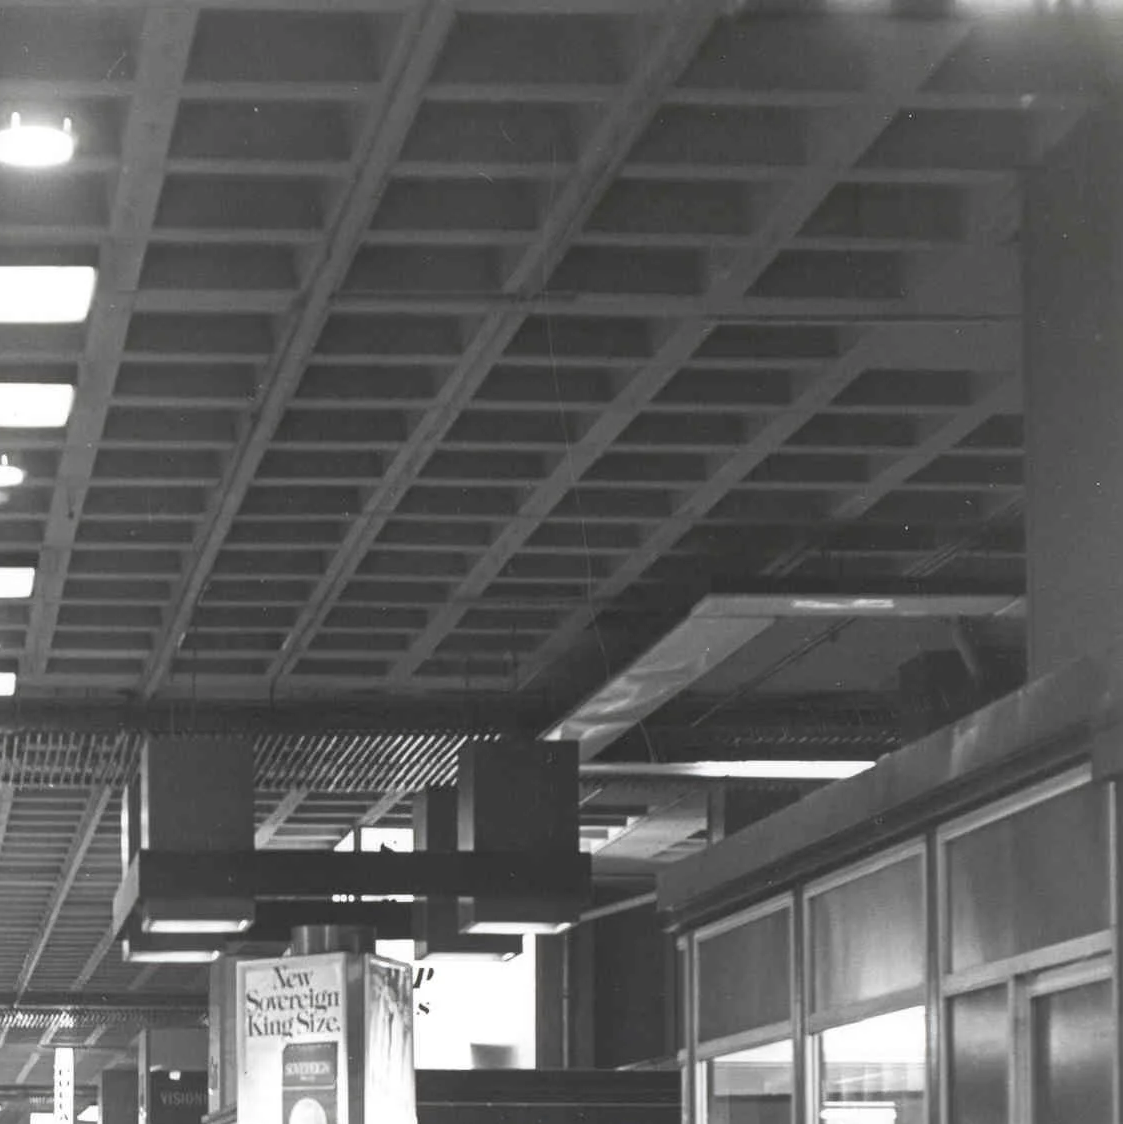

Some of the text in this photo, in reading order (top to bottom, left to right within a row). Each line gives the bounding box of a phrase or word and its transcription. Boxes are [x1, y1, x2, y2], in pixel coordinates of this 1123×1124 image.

[273, 966, 313, 989] New
[246, 987, 341, 1011] Sovereign
[247, 1013, 293, 1038] King
[159, 1091, 208, 1105] VISION
